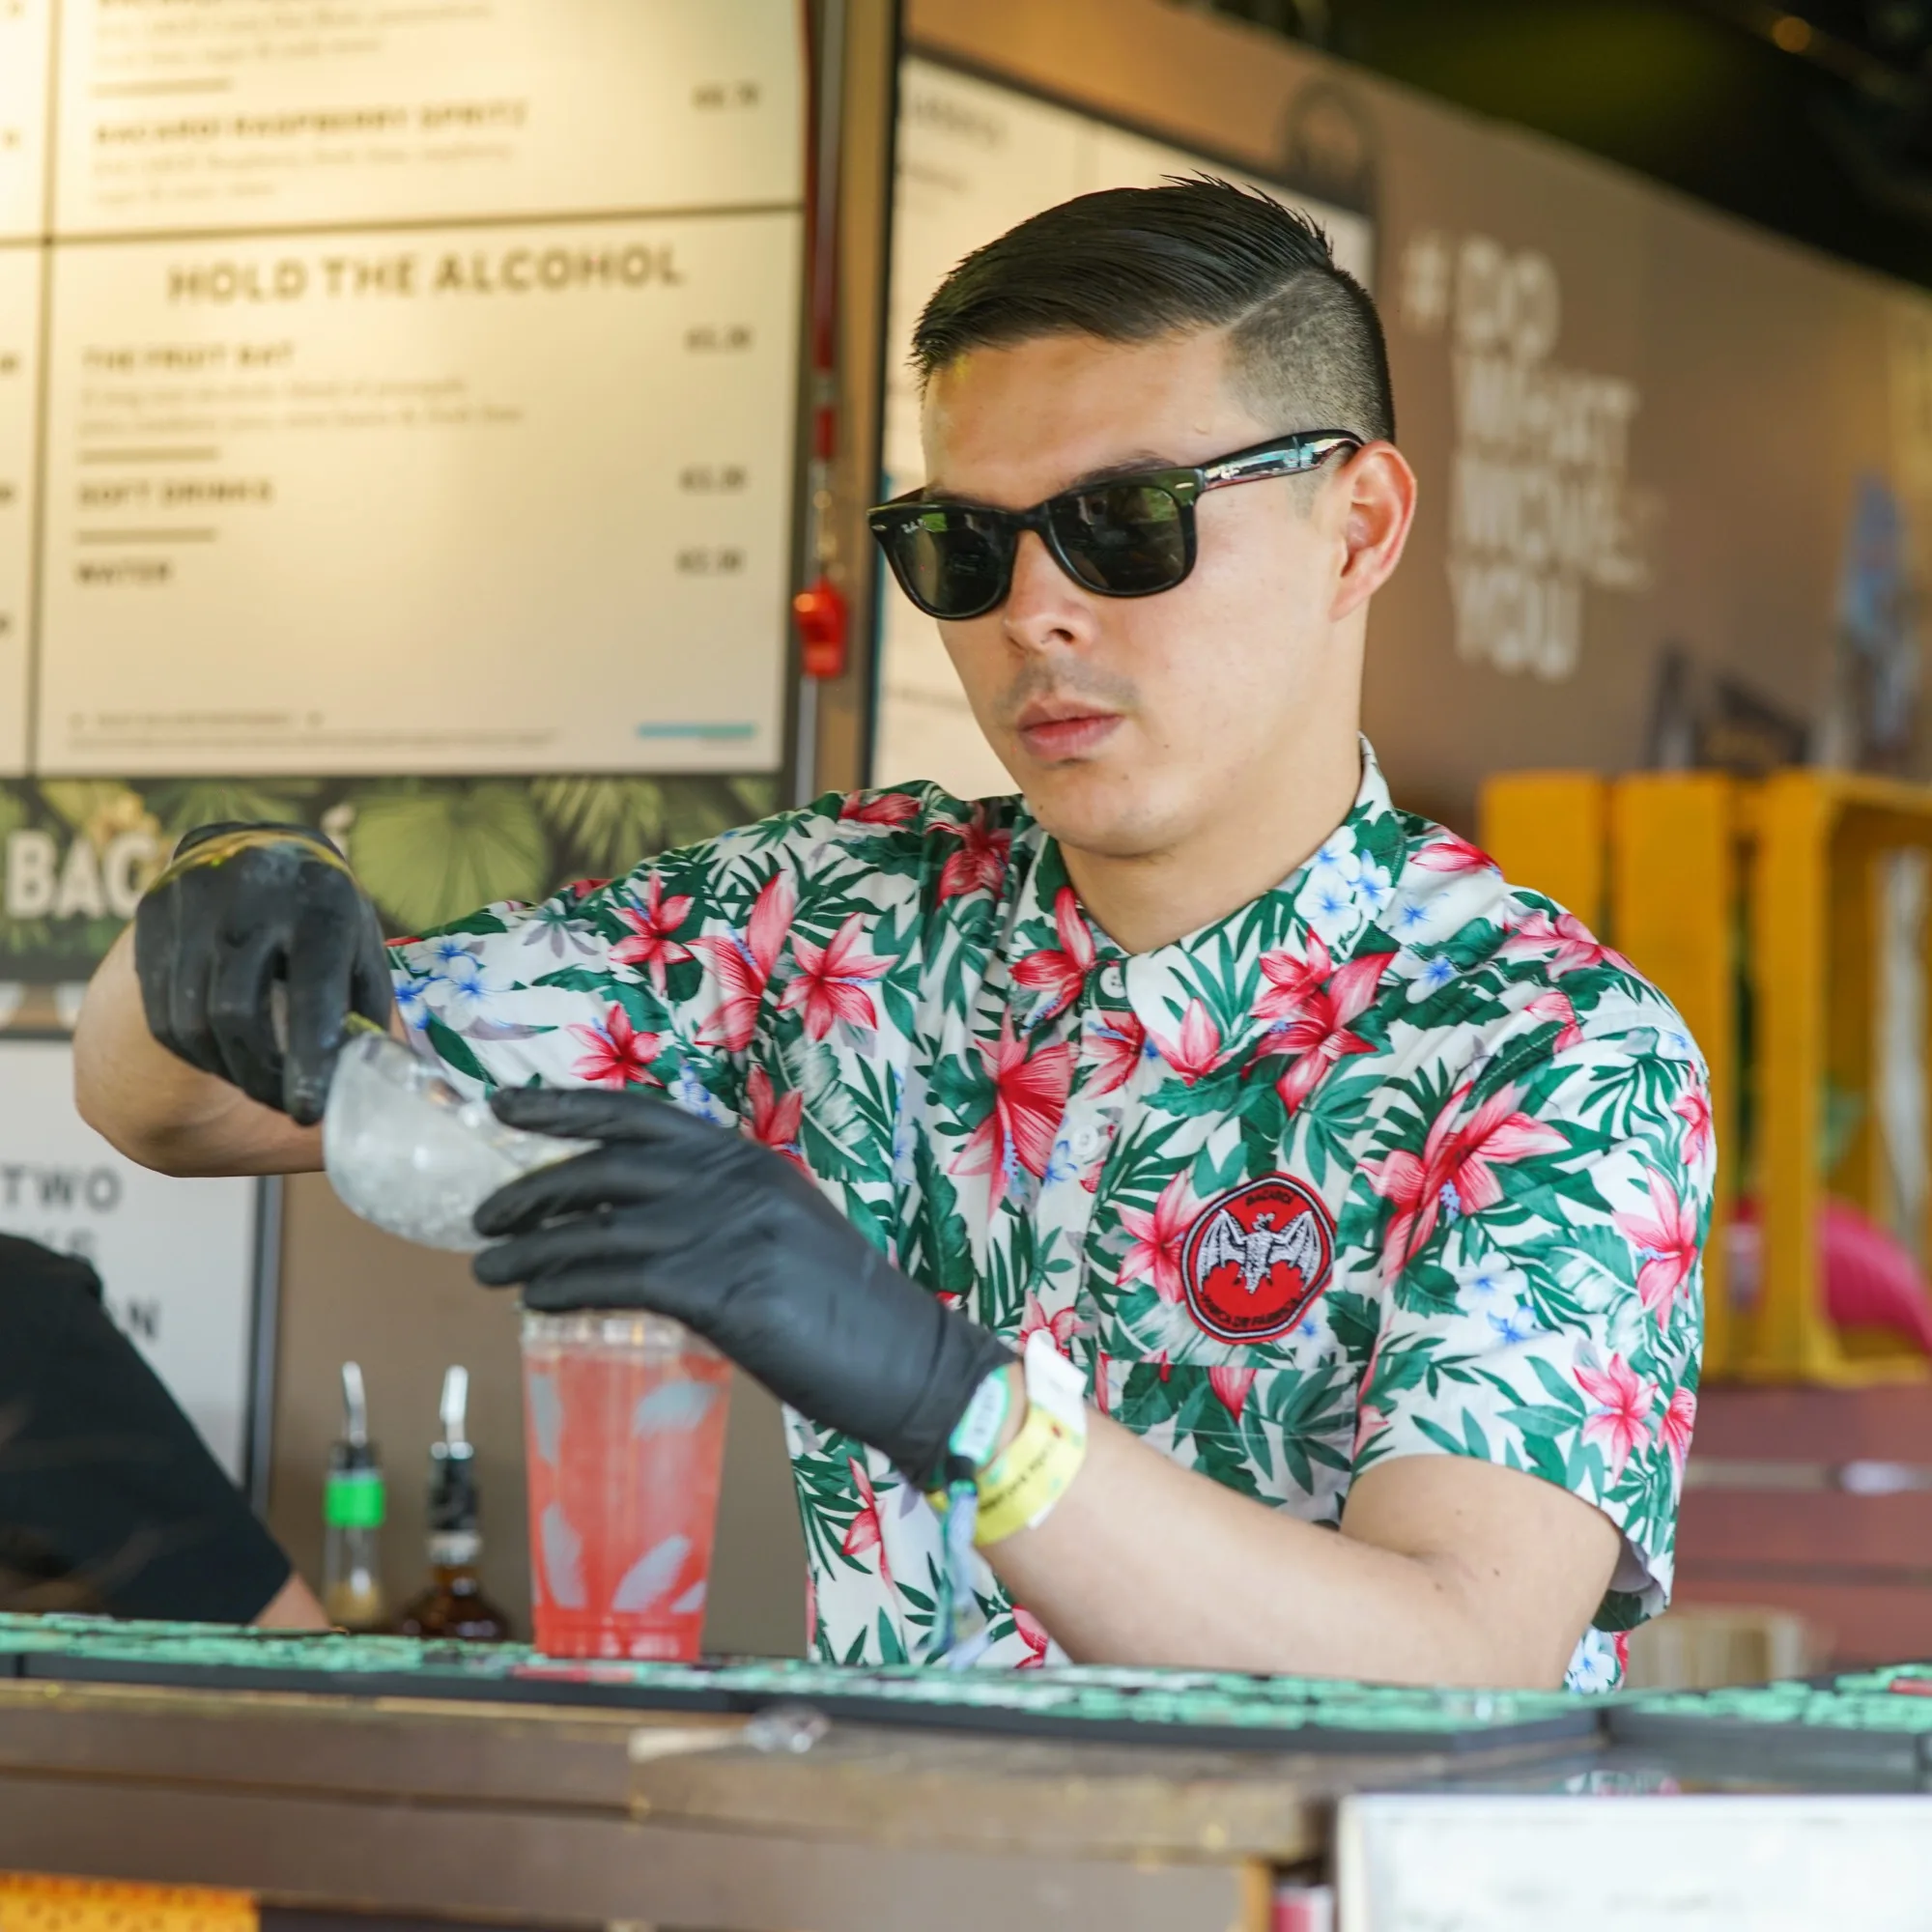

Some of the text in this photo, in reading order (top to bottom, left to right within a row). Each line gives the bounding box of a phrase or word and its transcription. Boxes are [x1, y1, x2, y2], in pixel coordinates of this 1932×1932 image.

[168, 241, 686, 304] HOLD THE ALCOHOL
[81, 345, 135, 373] THE
[143, 342, 226, 372] FRUIT
[80, 476, 274, 509] SOFT DRINKS
[79, 558, 174, 587] WATER
[2, 1162, 124, 1215] TWO
